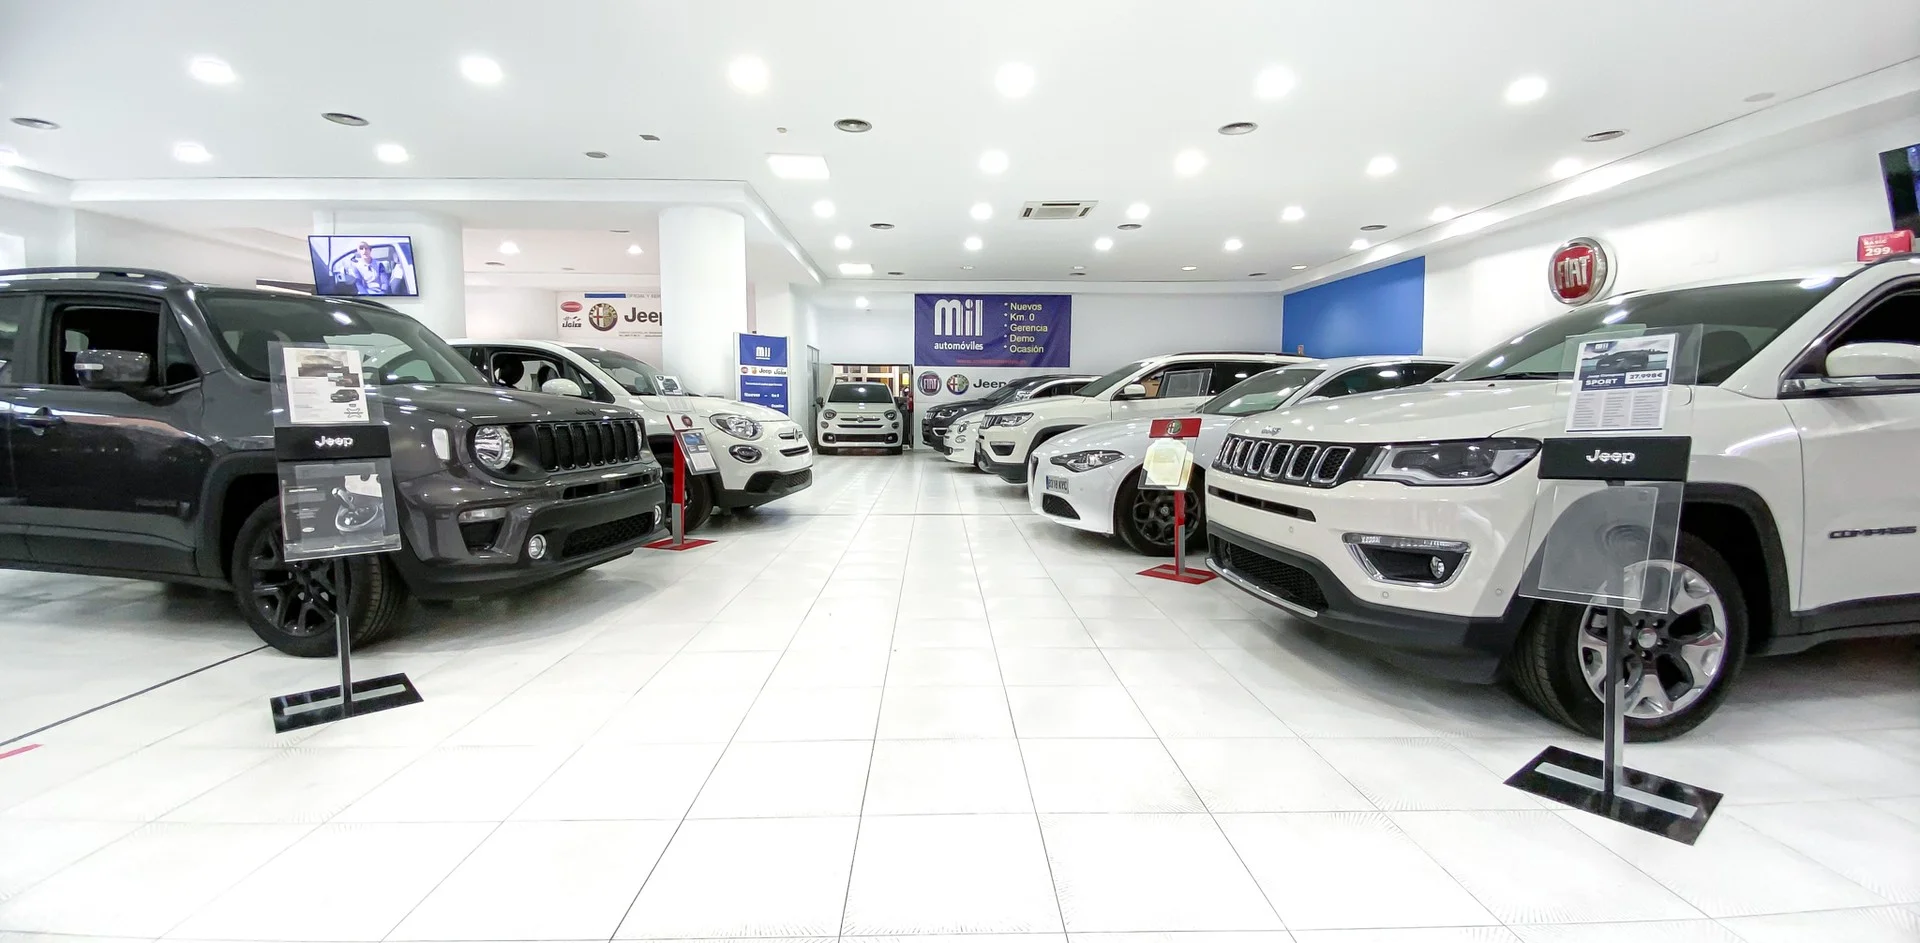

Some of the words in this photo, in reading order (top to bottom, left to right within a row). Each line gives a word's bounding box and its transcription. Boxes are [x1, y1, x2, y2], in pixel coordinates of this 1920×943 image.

[1864, 247, 1891, 257] 299
[1557, 255, 1590, 290] FIAT
[1010, 302, 1042, 311] Nuevos
[934, 298, 983, 336] mil
[1029, 313, 1035, 321] 0
[1010, 323, 1048, 332] Gerencia
[1010, 334, 1035, 343] Demo
[934, 340, 983, 351] automóviles
[1010, 344, 1044, 353] Ocasión
[923, 378, 937, 390] FIAT
[1585, 378, 1618, 386] SPORT
[314, 435, 354, 448] Jeep
[1585, 449, 1636, 464] Jeep
